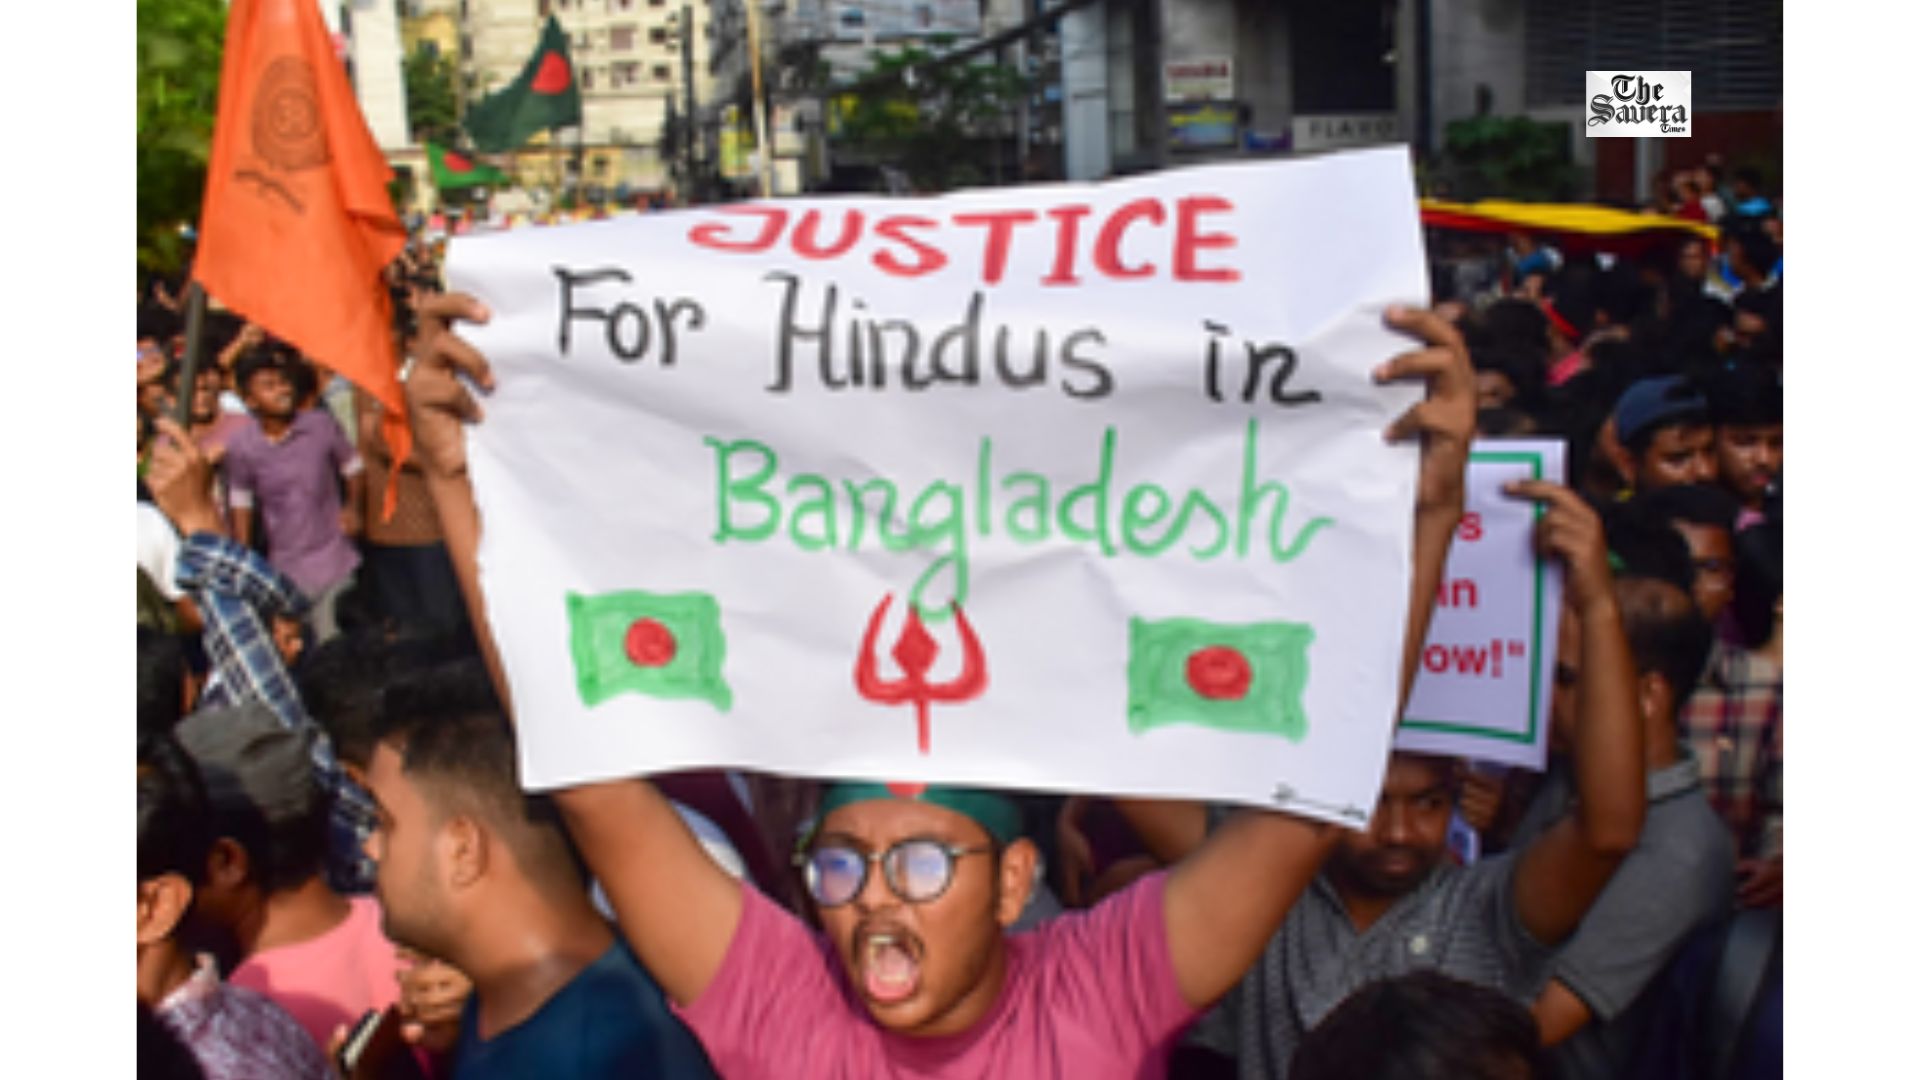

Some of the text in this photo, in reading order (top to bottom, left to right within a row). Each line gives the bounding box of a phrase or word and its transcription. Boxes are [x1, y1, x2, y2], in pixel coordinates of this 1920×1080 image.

[688, 197, 1243, 286] JUSTICE
[553, 266, 1323, 408] For Hindus in
[703, 417, 1334, 622] Bangladesh
